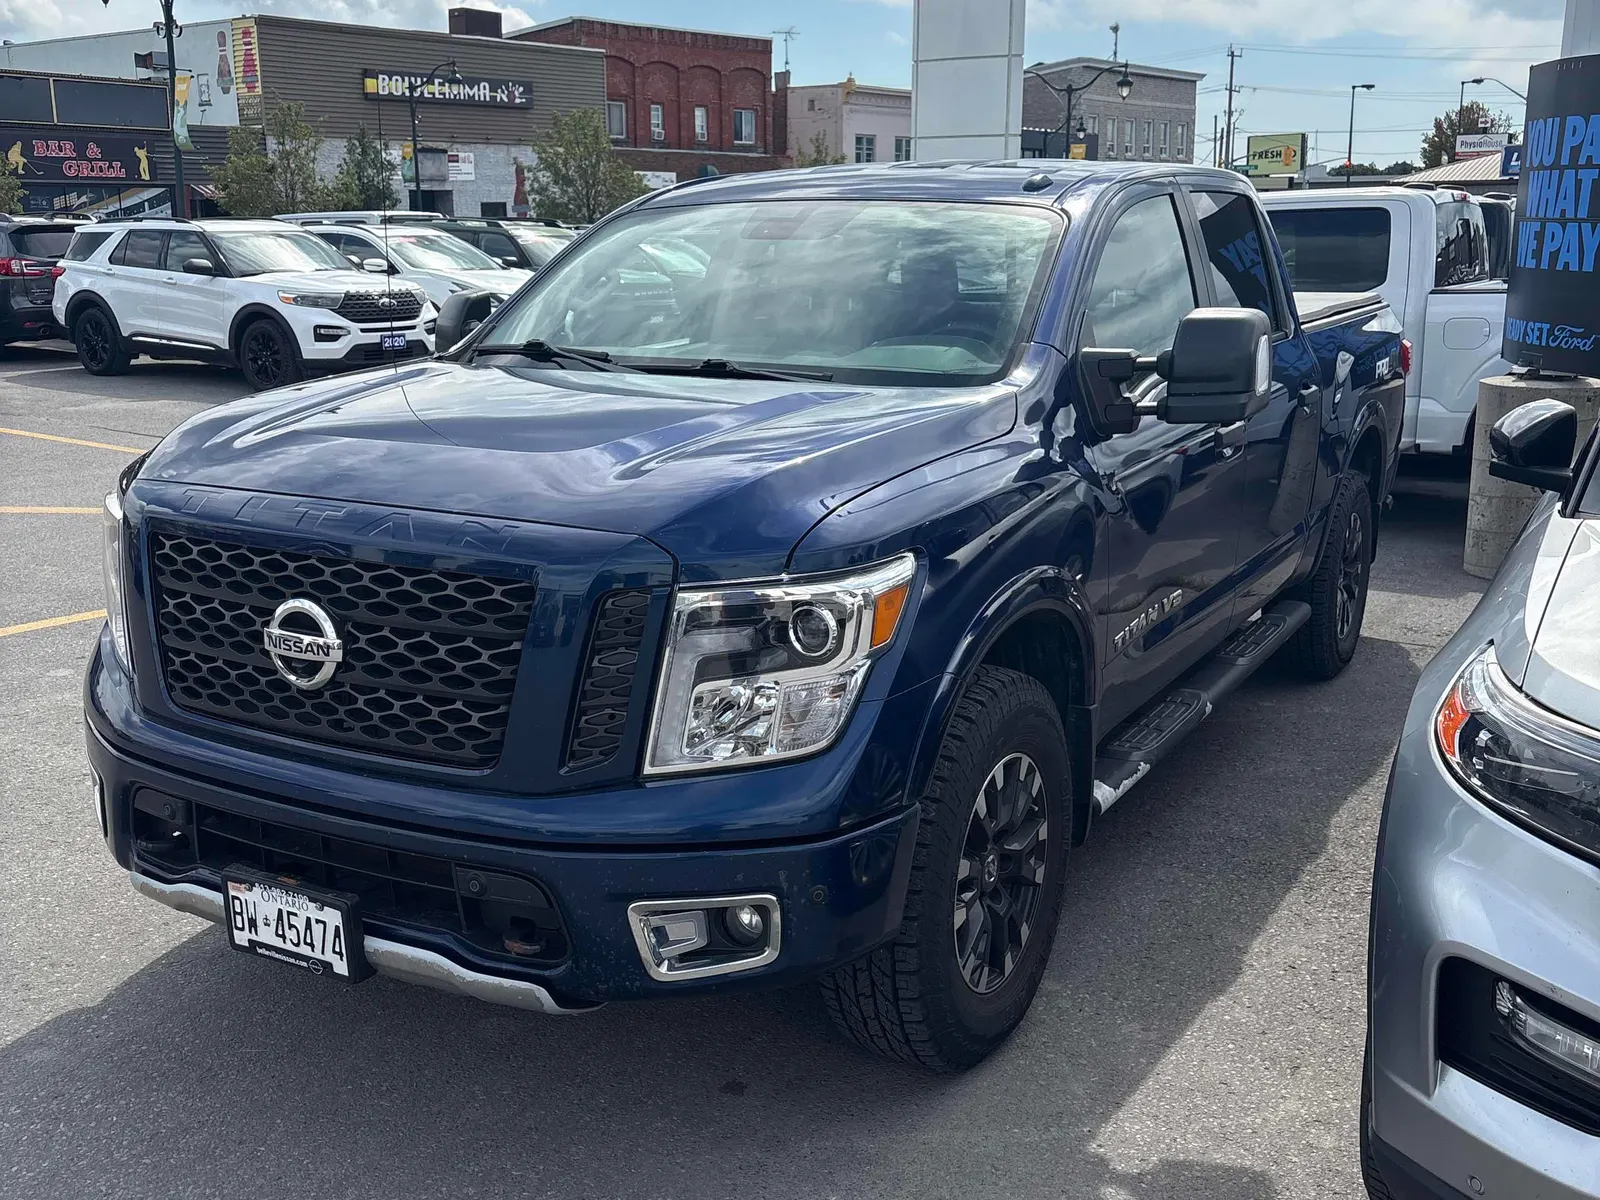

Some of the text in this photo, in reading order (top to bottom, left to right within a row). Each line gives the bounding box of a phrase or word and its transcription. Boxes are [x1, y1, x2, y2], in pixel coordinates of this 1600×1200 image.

[33, 140, 101, 158] BAR &
[1460, 139, 1503, 149] PhysioHouse
[1526, 117, 1560, 168] YOU
[63, 160, 126, 177] GRILL
[1526, 169, 1599, 219] WHAT
[1516, 221, 1600, 272] WE PAY
[1526, 321, 1550, 346] SET
[1549, 325, 1595, 351] Ford
[180, 488, 520, 551] TITAN
[267, 633, 331, 657] NISSAN
[1113, 589, 1183, 653] TITAN V8
[231, 895, 344, 962] BW 45474
